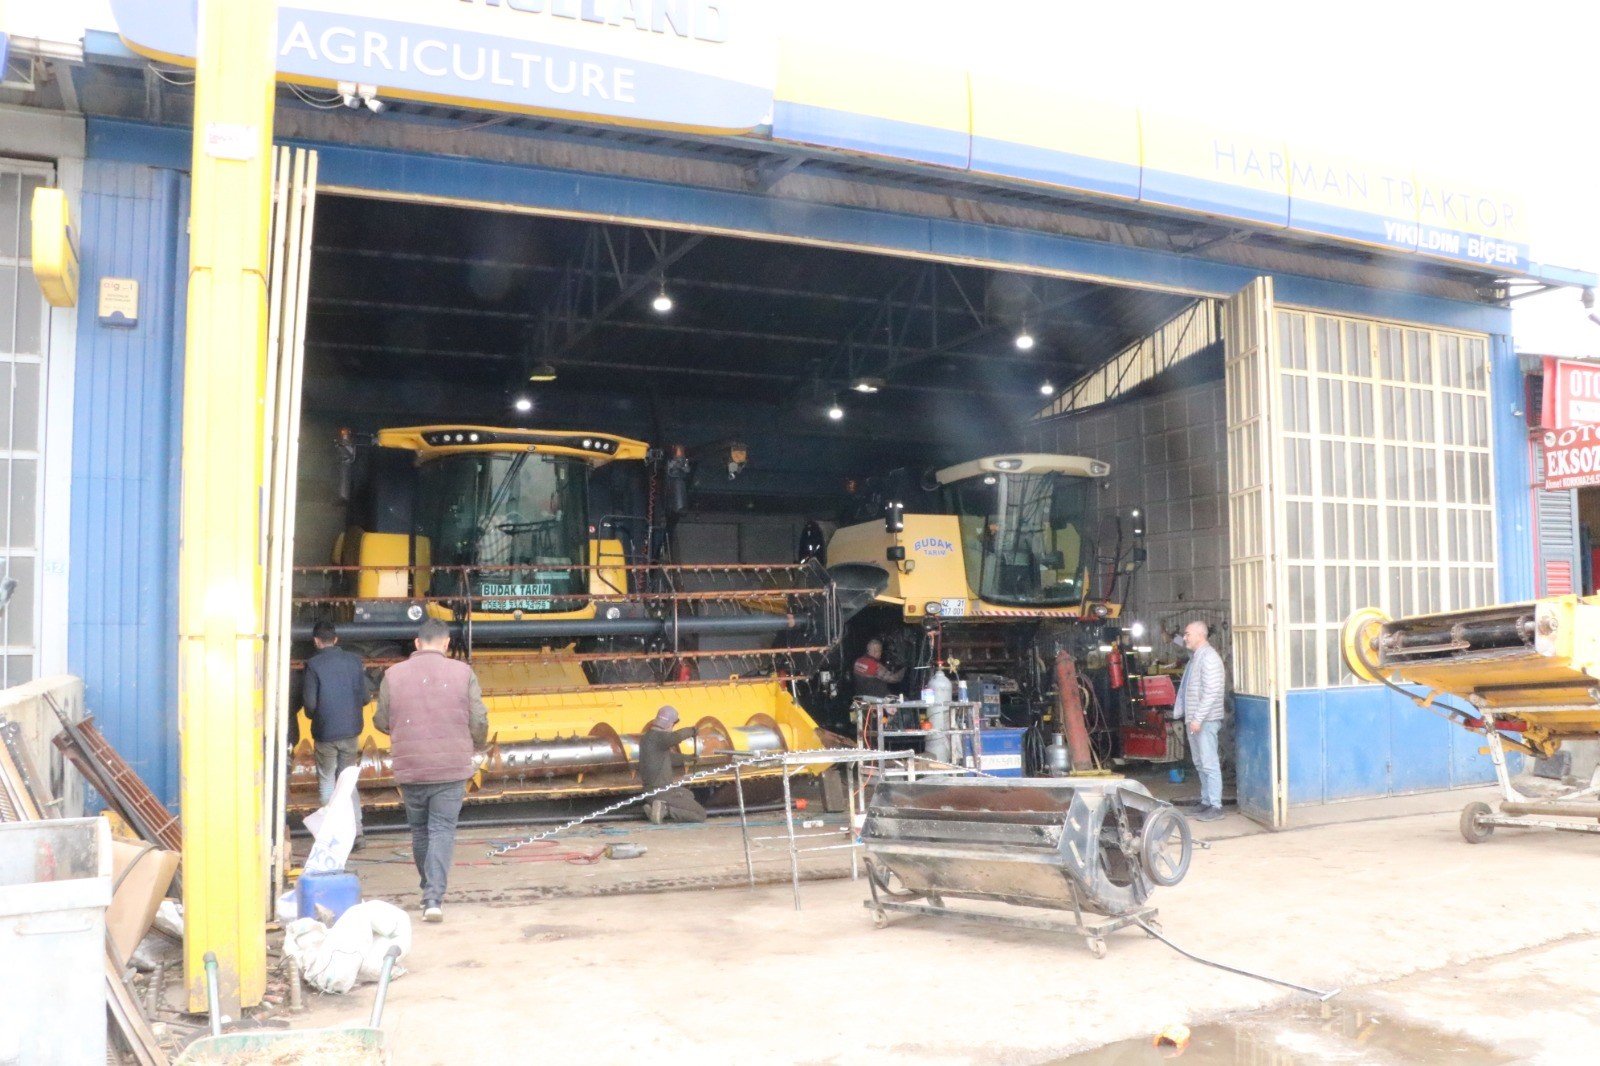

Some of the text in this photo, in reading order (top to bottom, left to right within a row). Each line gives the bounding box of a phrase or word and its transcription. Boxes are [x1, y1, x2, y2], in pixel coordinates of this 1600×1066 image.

[280, 20, 637, 104] AGRICULTURE
[1213, 139, 1369, 200] HARMAN
[914, 538, 953, 552] BUDAK
[483, 584, 550, 596] BUDAK TARIM
